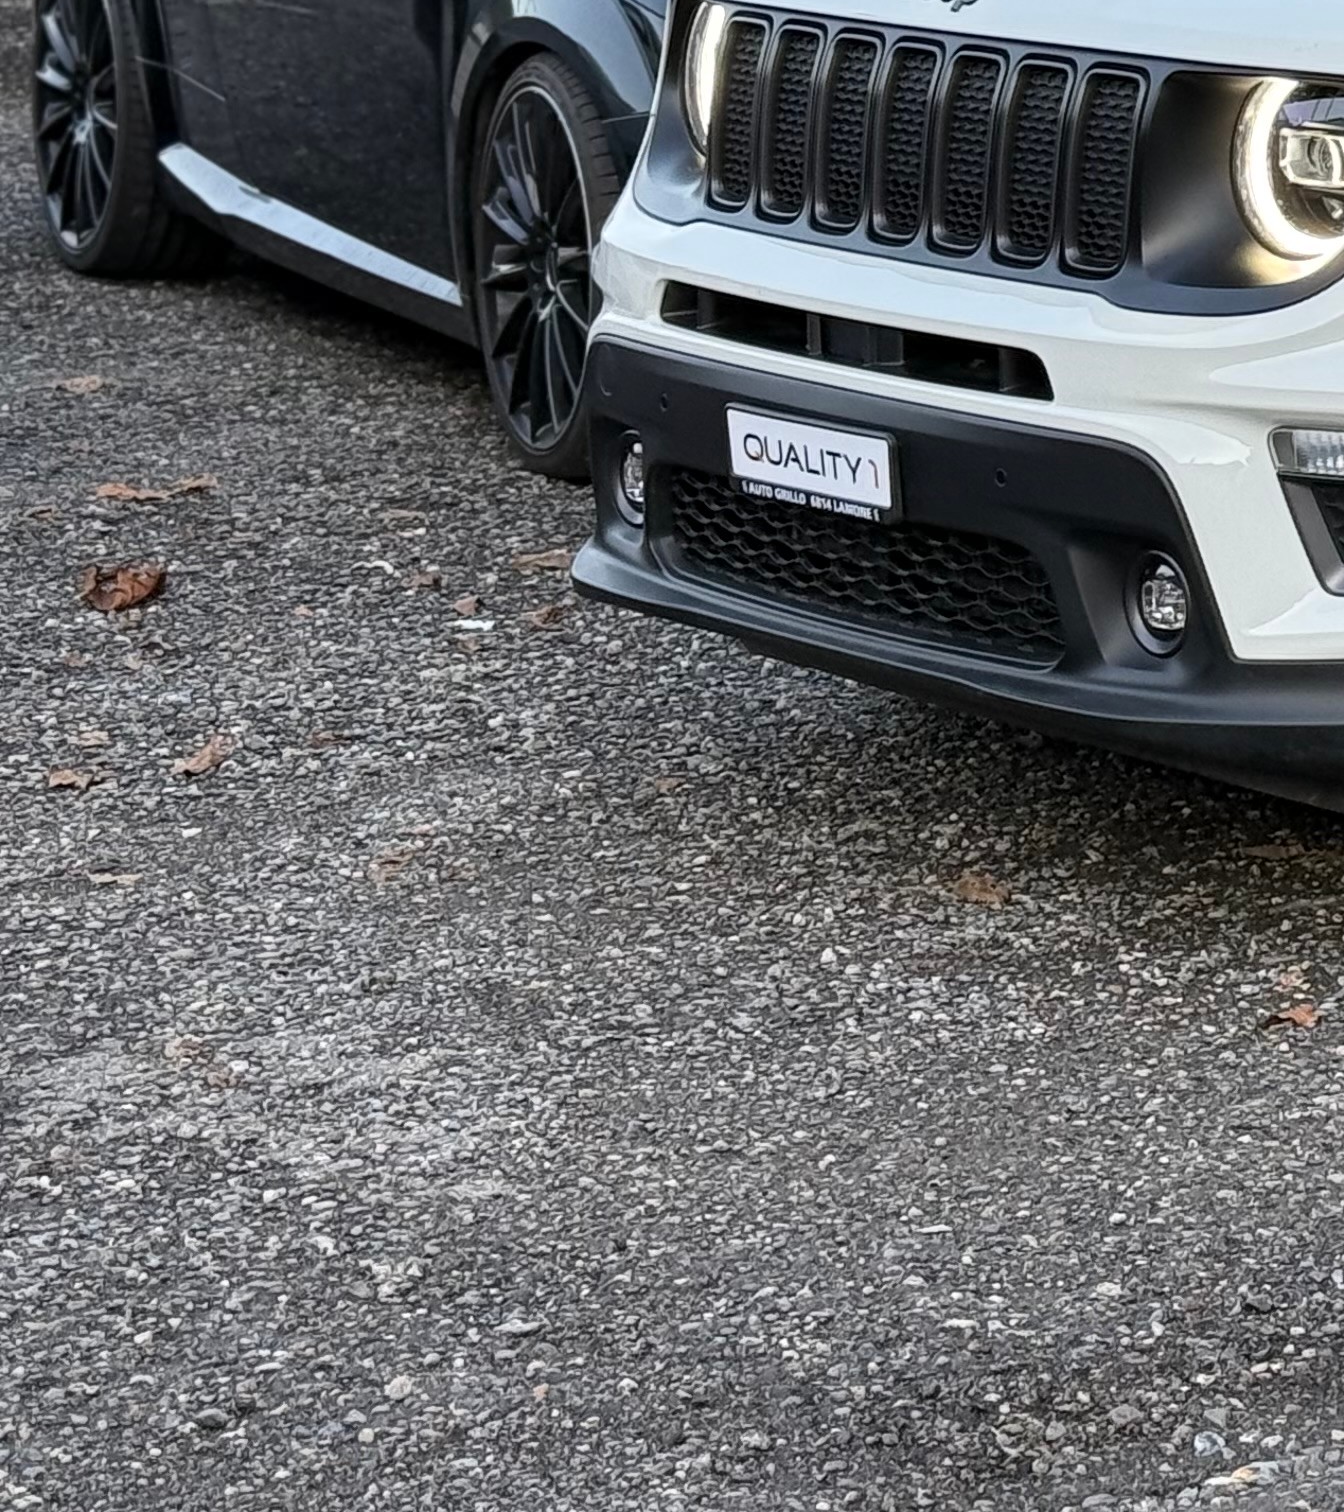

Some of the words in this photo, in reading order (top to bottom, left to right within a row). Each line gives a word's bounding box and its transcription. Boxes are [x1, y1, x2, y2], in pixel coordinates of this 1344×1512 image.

[743, 433, 862, 484] QUALITY
[867, 458, 880, 489] 1
[749, 481, 774, 499] AUTO
[775, 487, 807, 506] GRILLO
